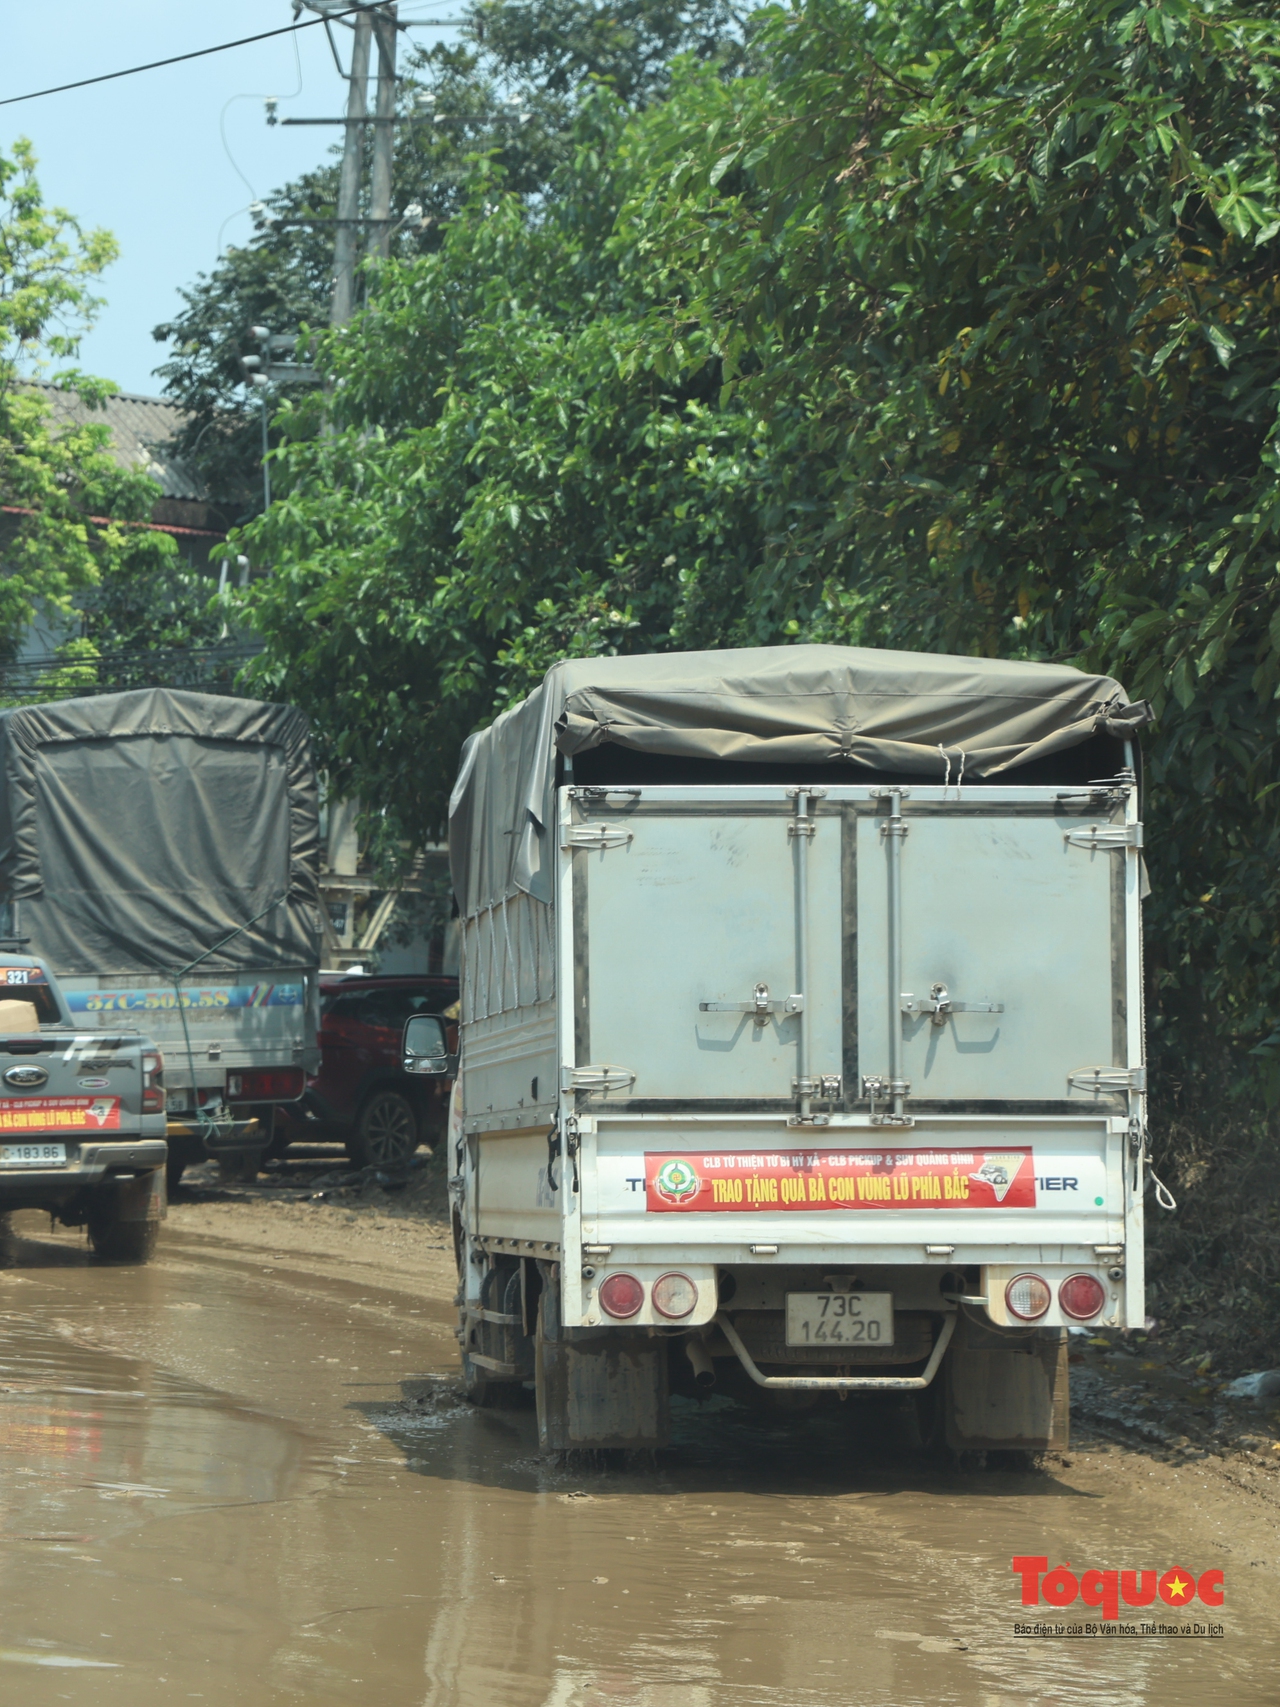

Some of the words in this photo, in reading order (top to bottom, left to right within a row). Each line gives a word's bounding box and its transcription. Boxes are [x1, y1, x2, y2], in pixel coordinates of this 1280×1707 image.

[7, 971, 28, 984] 321
[704, 1157, 721, 1168] CLB
[724, 1155, 735, 1168] TỪ
[737, 1155, 763, 1170] THIỆN
[766, 1155, 778, 1168] TỪ
[780, 1156, 790, 1166] BI
[828, 1155, 846, 1166] CLB
[849, 1154, 883, 1165] PICKUP
[885, 1154, 893, 1165] &
[896, 1154, 915, 1165] SUV
[916, 1152, 948, 1165] QUẢNG
[951, 1152, 974, 1165] BÌNH
[712, 1178, 743, 1203] TRAO
[745, 1174, 778, 1208] TẶNG
[780, 1173, 808, 1204] QUÀ
[810, 1173, 827, 1202] BÀ
[829, 1177, 855, 1202] CON
[856, 1174, 891, 1201] VÙNG
[894, 1172, 909, 1201] LŨ
[912, 1171, 941, 1200] PHÍA
[944, 1167, 970, 1200] BẮC
[817, 1296, 862, 1317] 73C
[802, 1320, 881, 1342] 144.20
